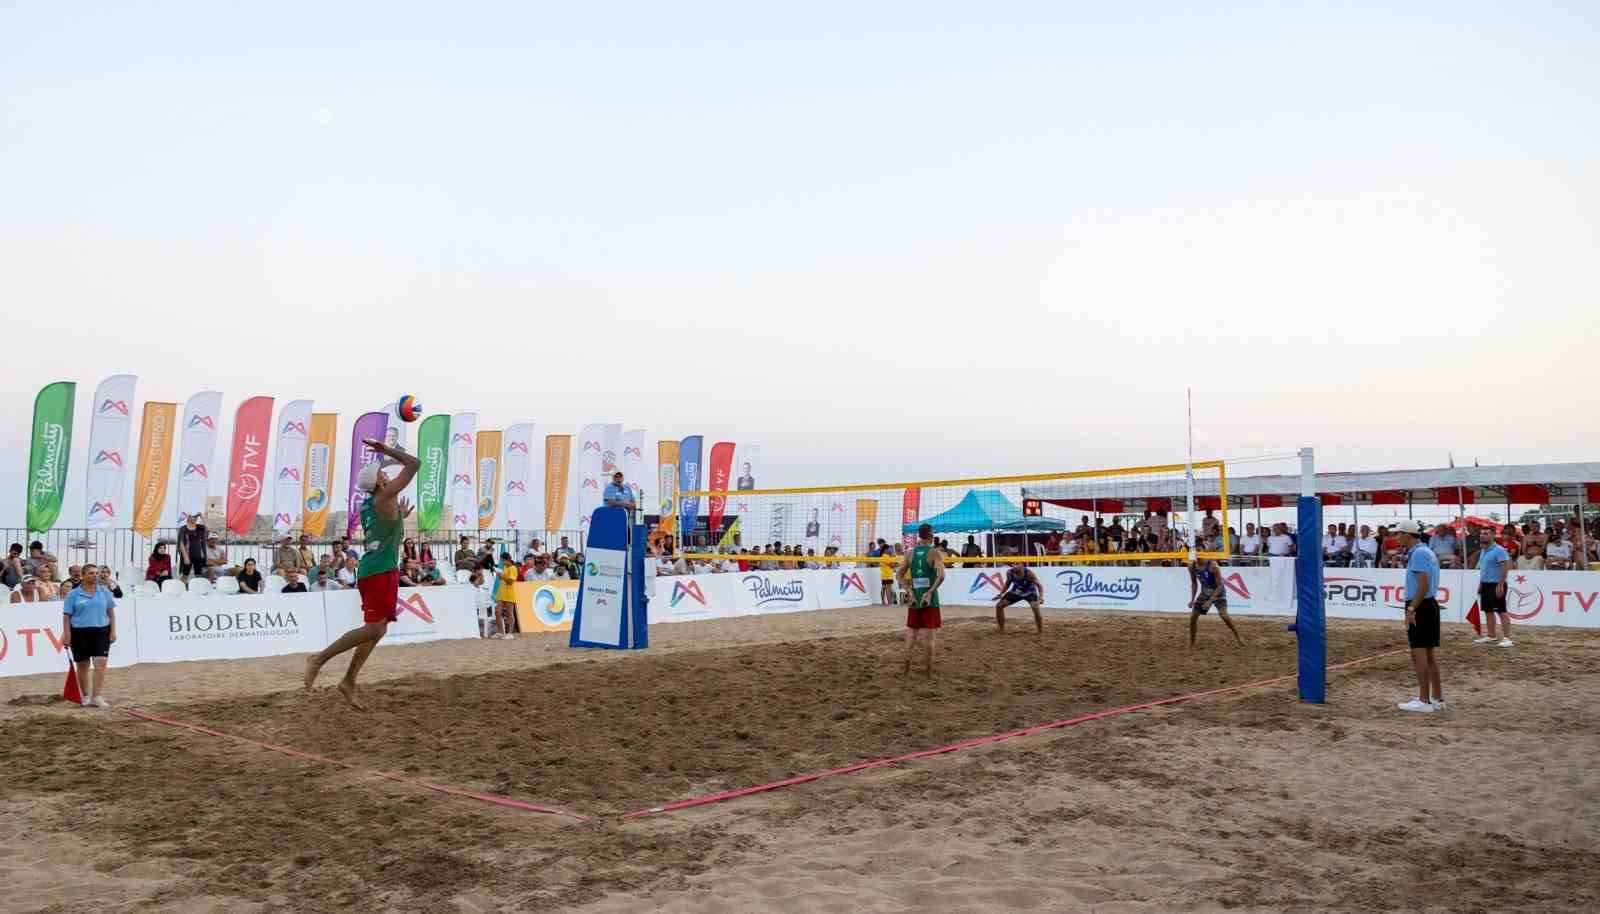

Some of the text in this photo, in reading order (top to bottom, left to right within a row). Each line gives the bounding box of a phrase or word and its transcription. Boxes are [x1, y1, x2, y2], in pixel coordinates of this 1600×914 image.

[32, 421, 64, 506] Palmcity
[242, 433, 262, 470] TVF
[743, 575, 804, 607] Palmcity
[1056, 569, 1143, 601] Palmcity
[169, 610, 298, 633] BIODERMA
[17, 627, 64, 657] TV
